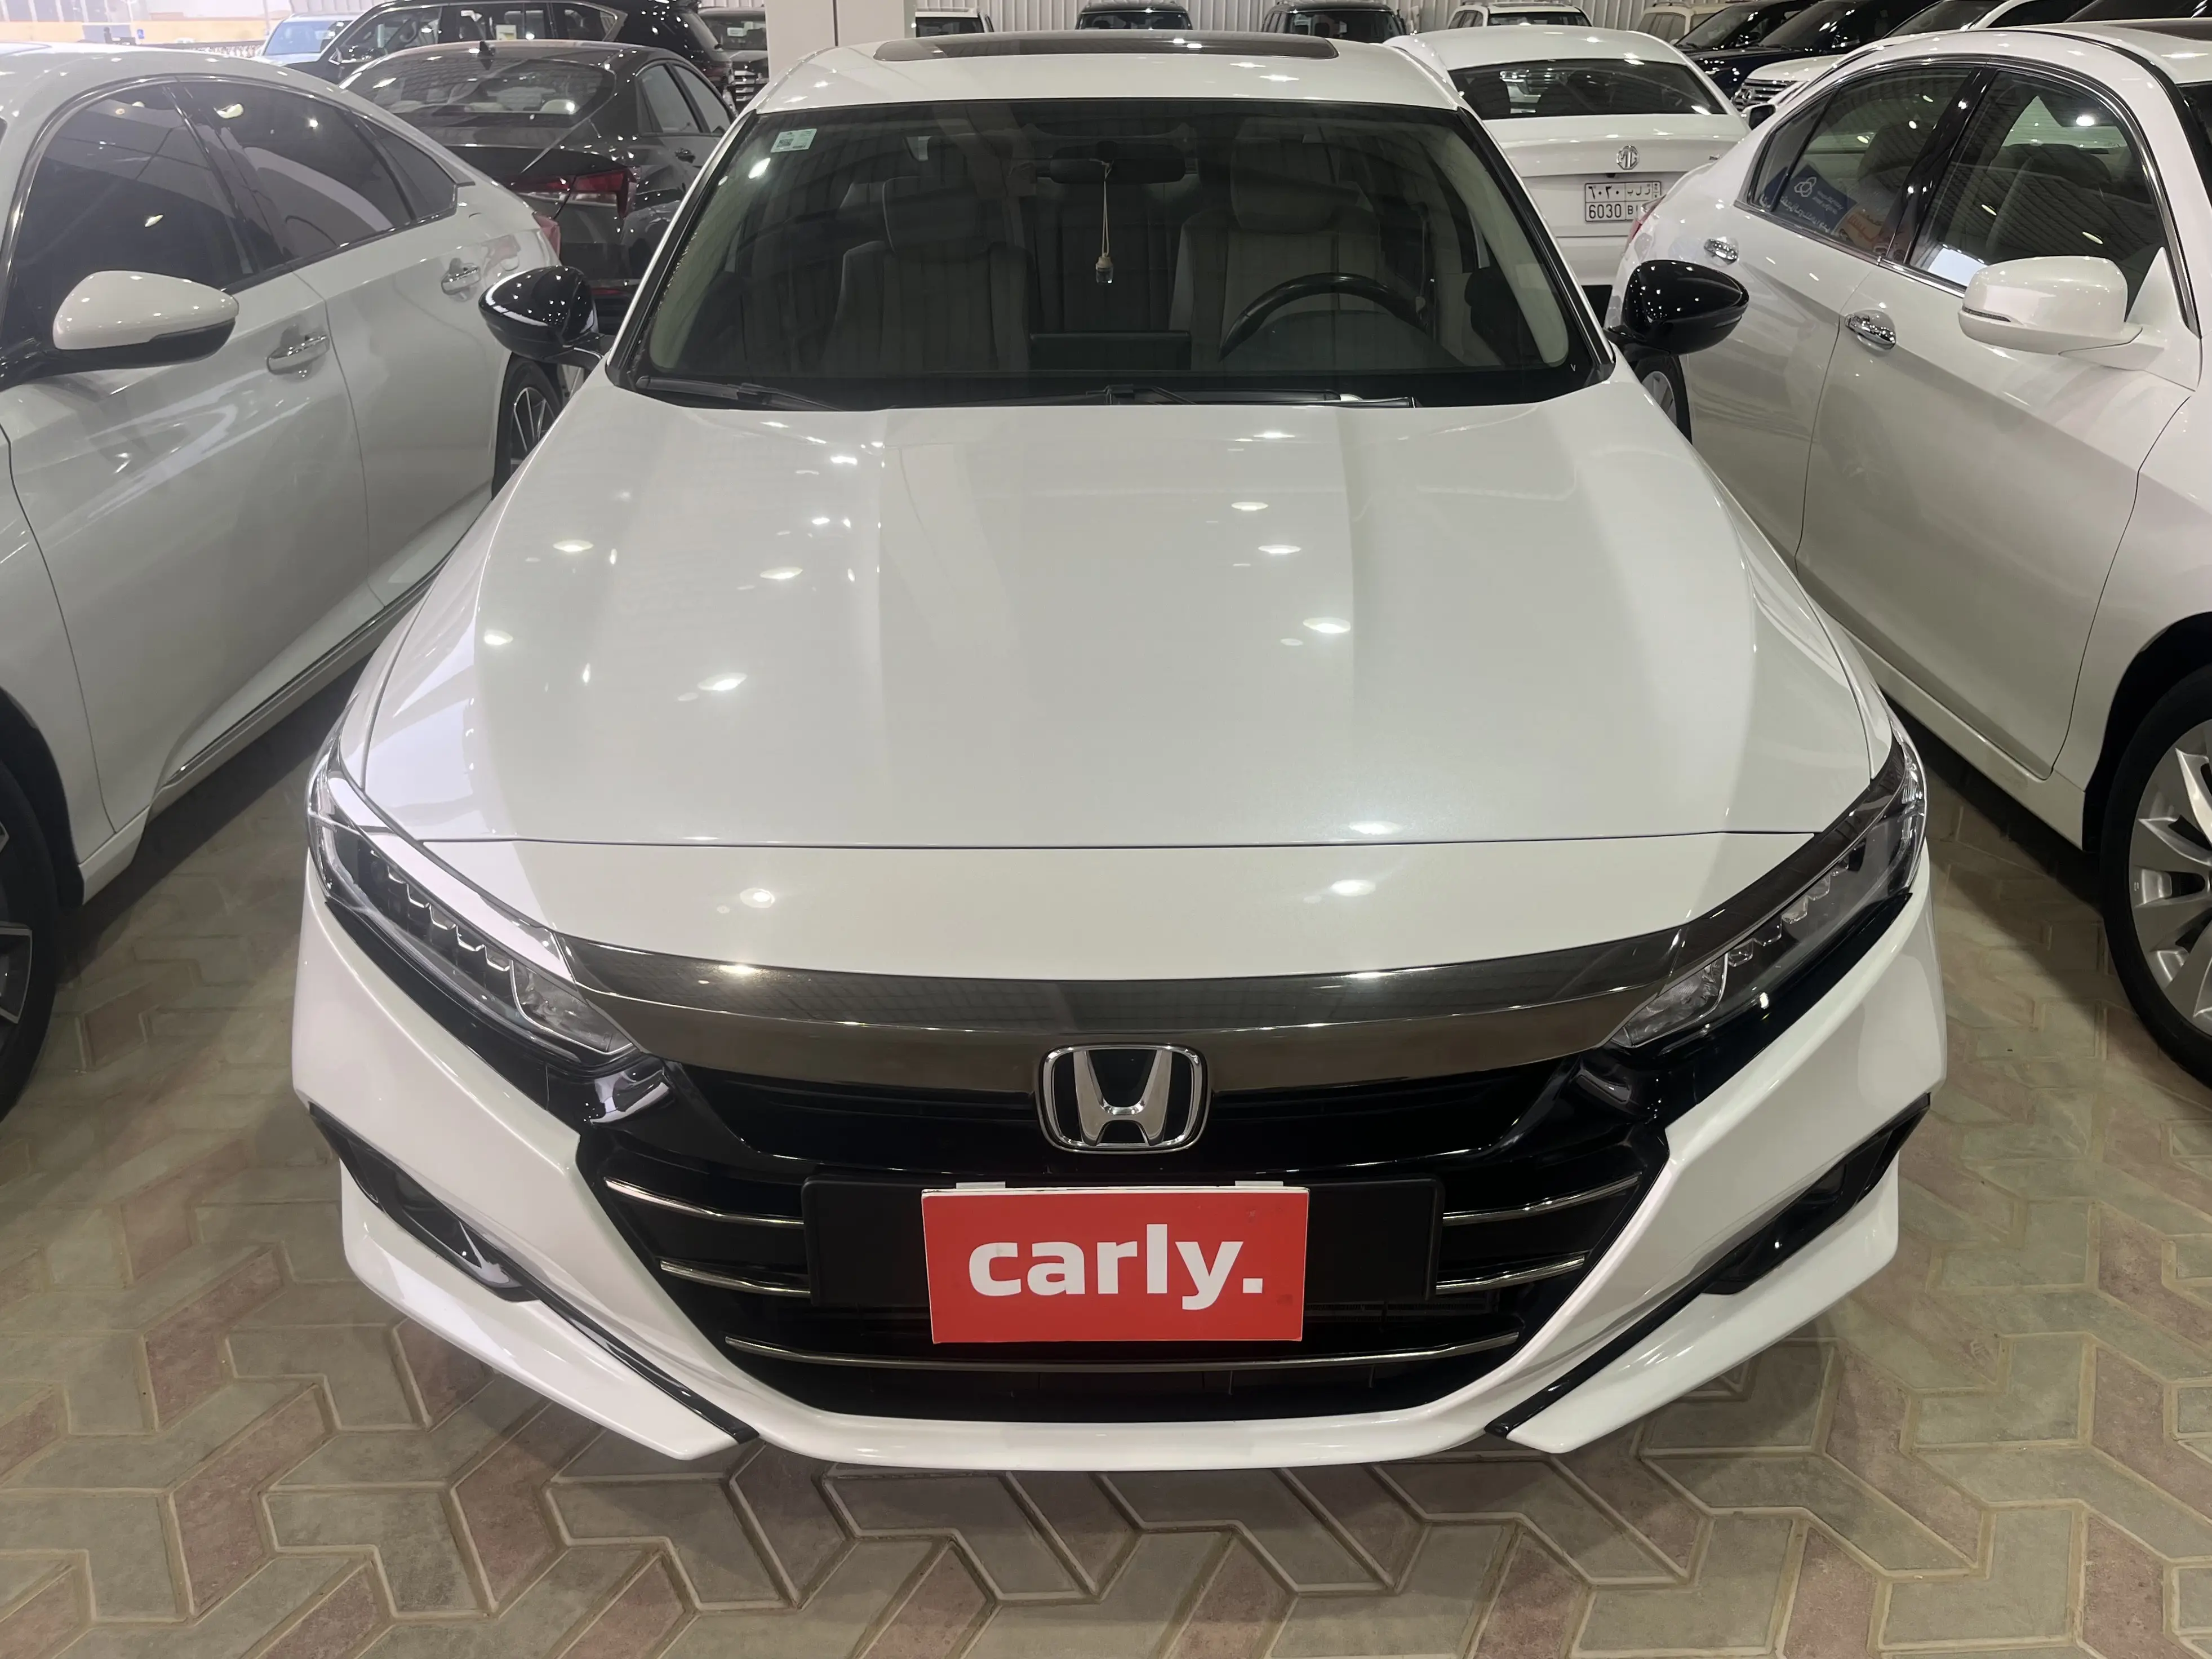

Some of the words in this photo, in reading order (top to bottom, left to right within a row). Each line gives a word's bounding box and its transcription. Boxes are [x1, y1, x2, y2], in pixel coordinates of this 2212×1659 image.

[1619, 147, 1637, 168] MG
[1589, 203, 1622, 219] 6030
[969, 1223, 1263, 1310] carly.
